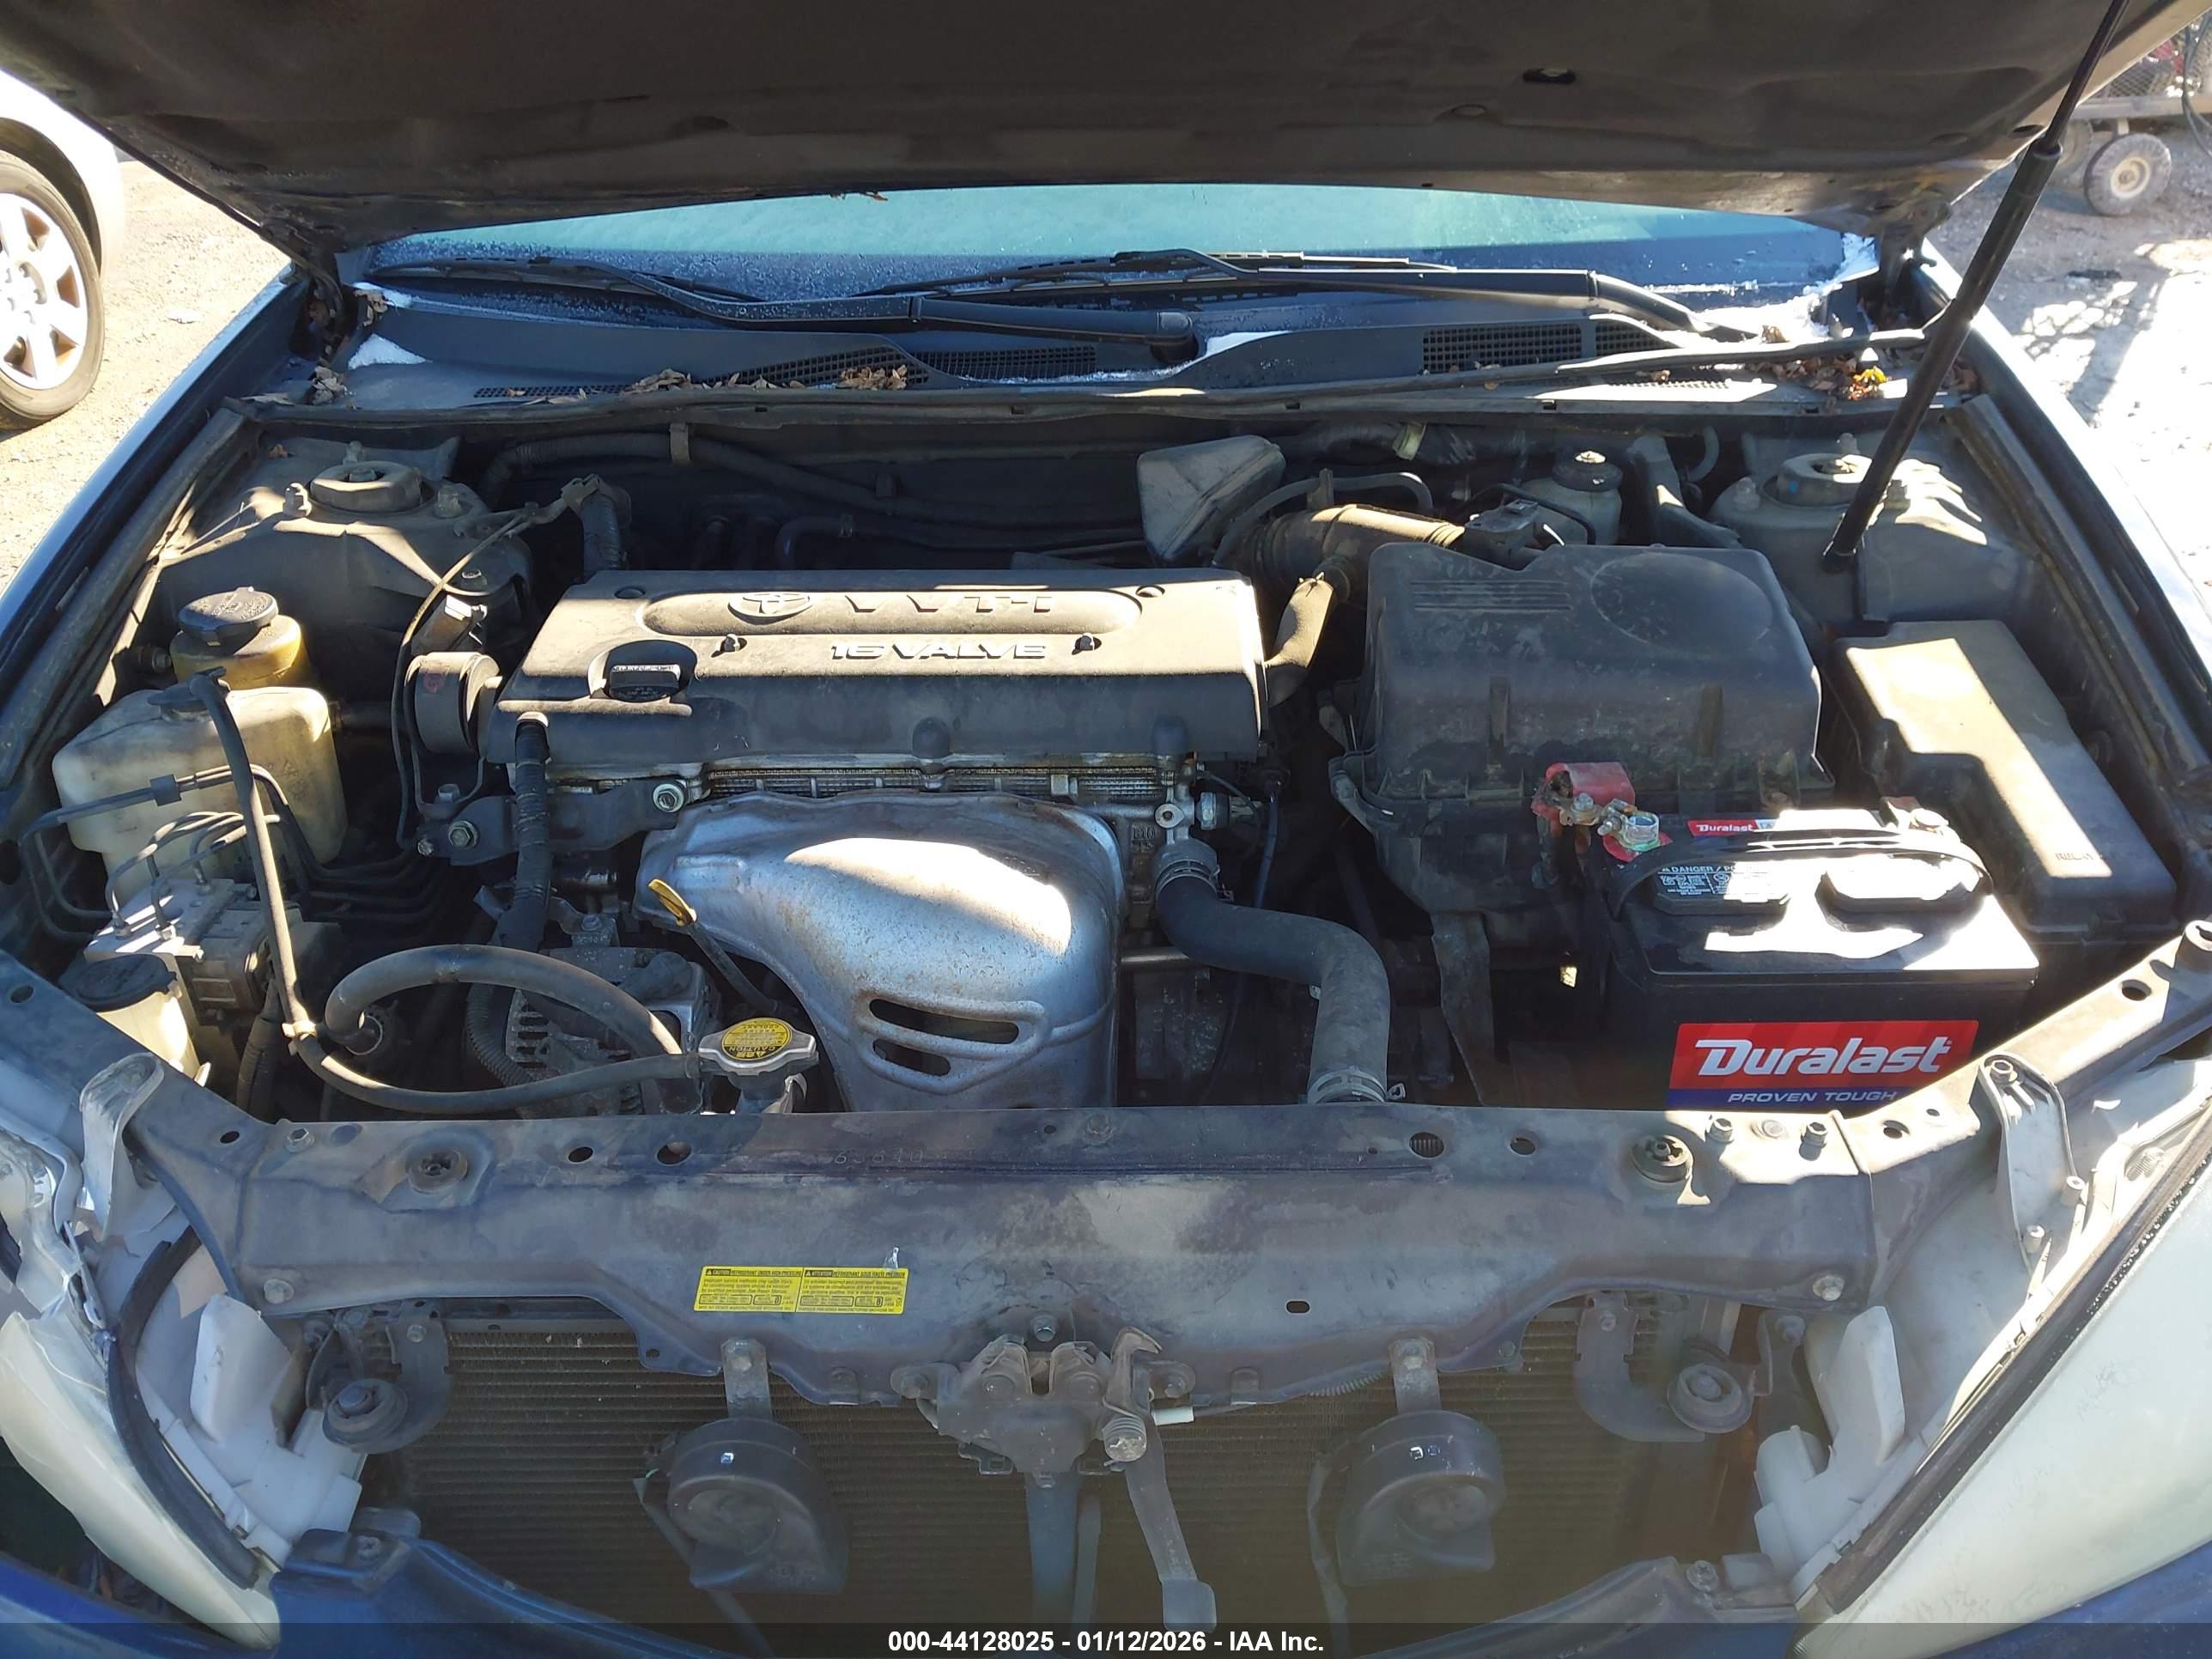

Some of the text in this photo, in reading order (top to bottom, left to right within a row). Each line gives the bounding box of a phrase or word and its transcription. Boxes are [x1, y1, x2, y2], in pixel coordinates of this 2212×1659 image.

[830, 644, 1047, 659] 16 VALVE
[1696, 823, 1753, 832] Duralast
[1694, 1036, 1953, 1076] Duralast
[1728, 1091, 1897, 1103] PROVEN TOUGH
